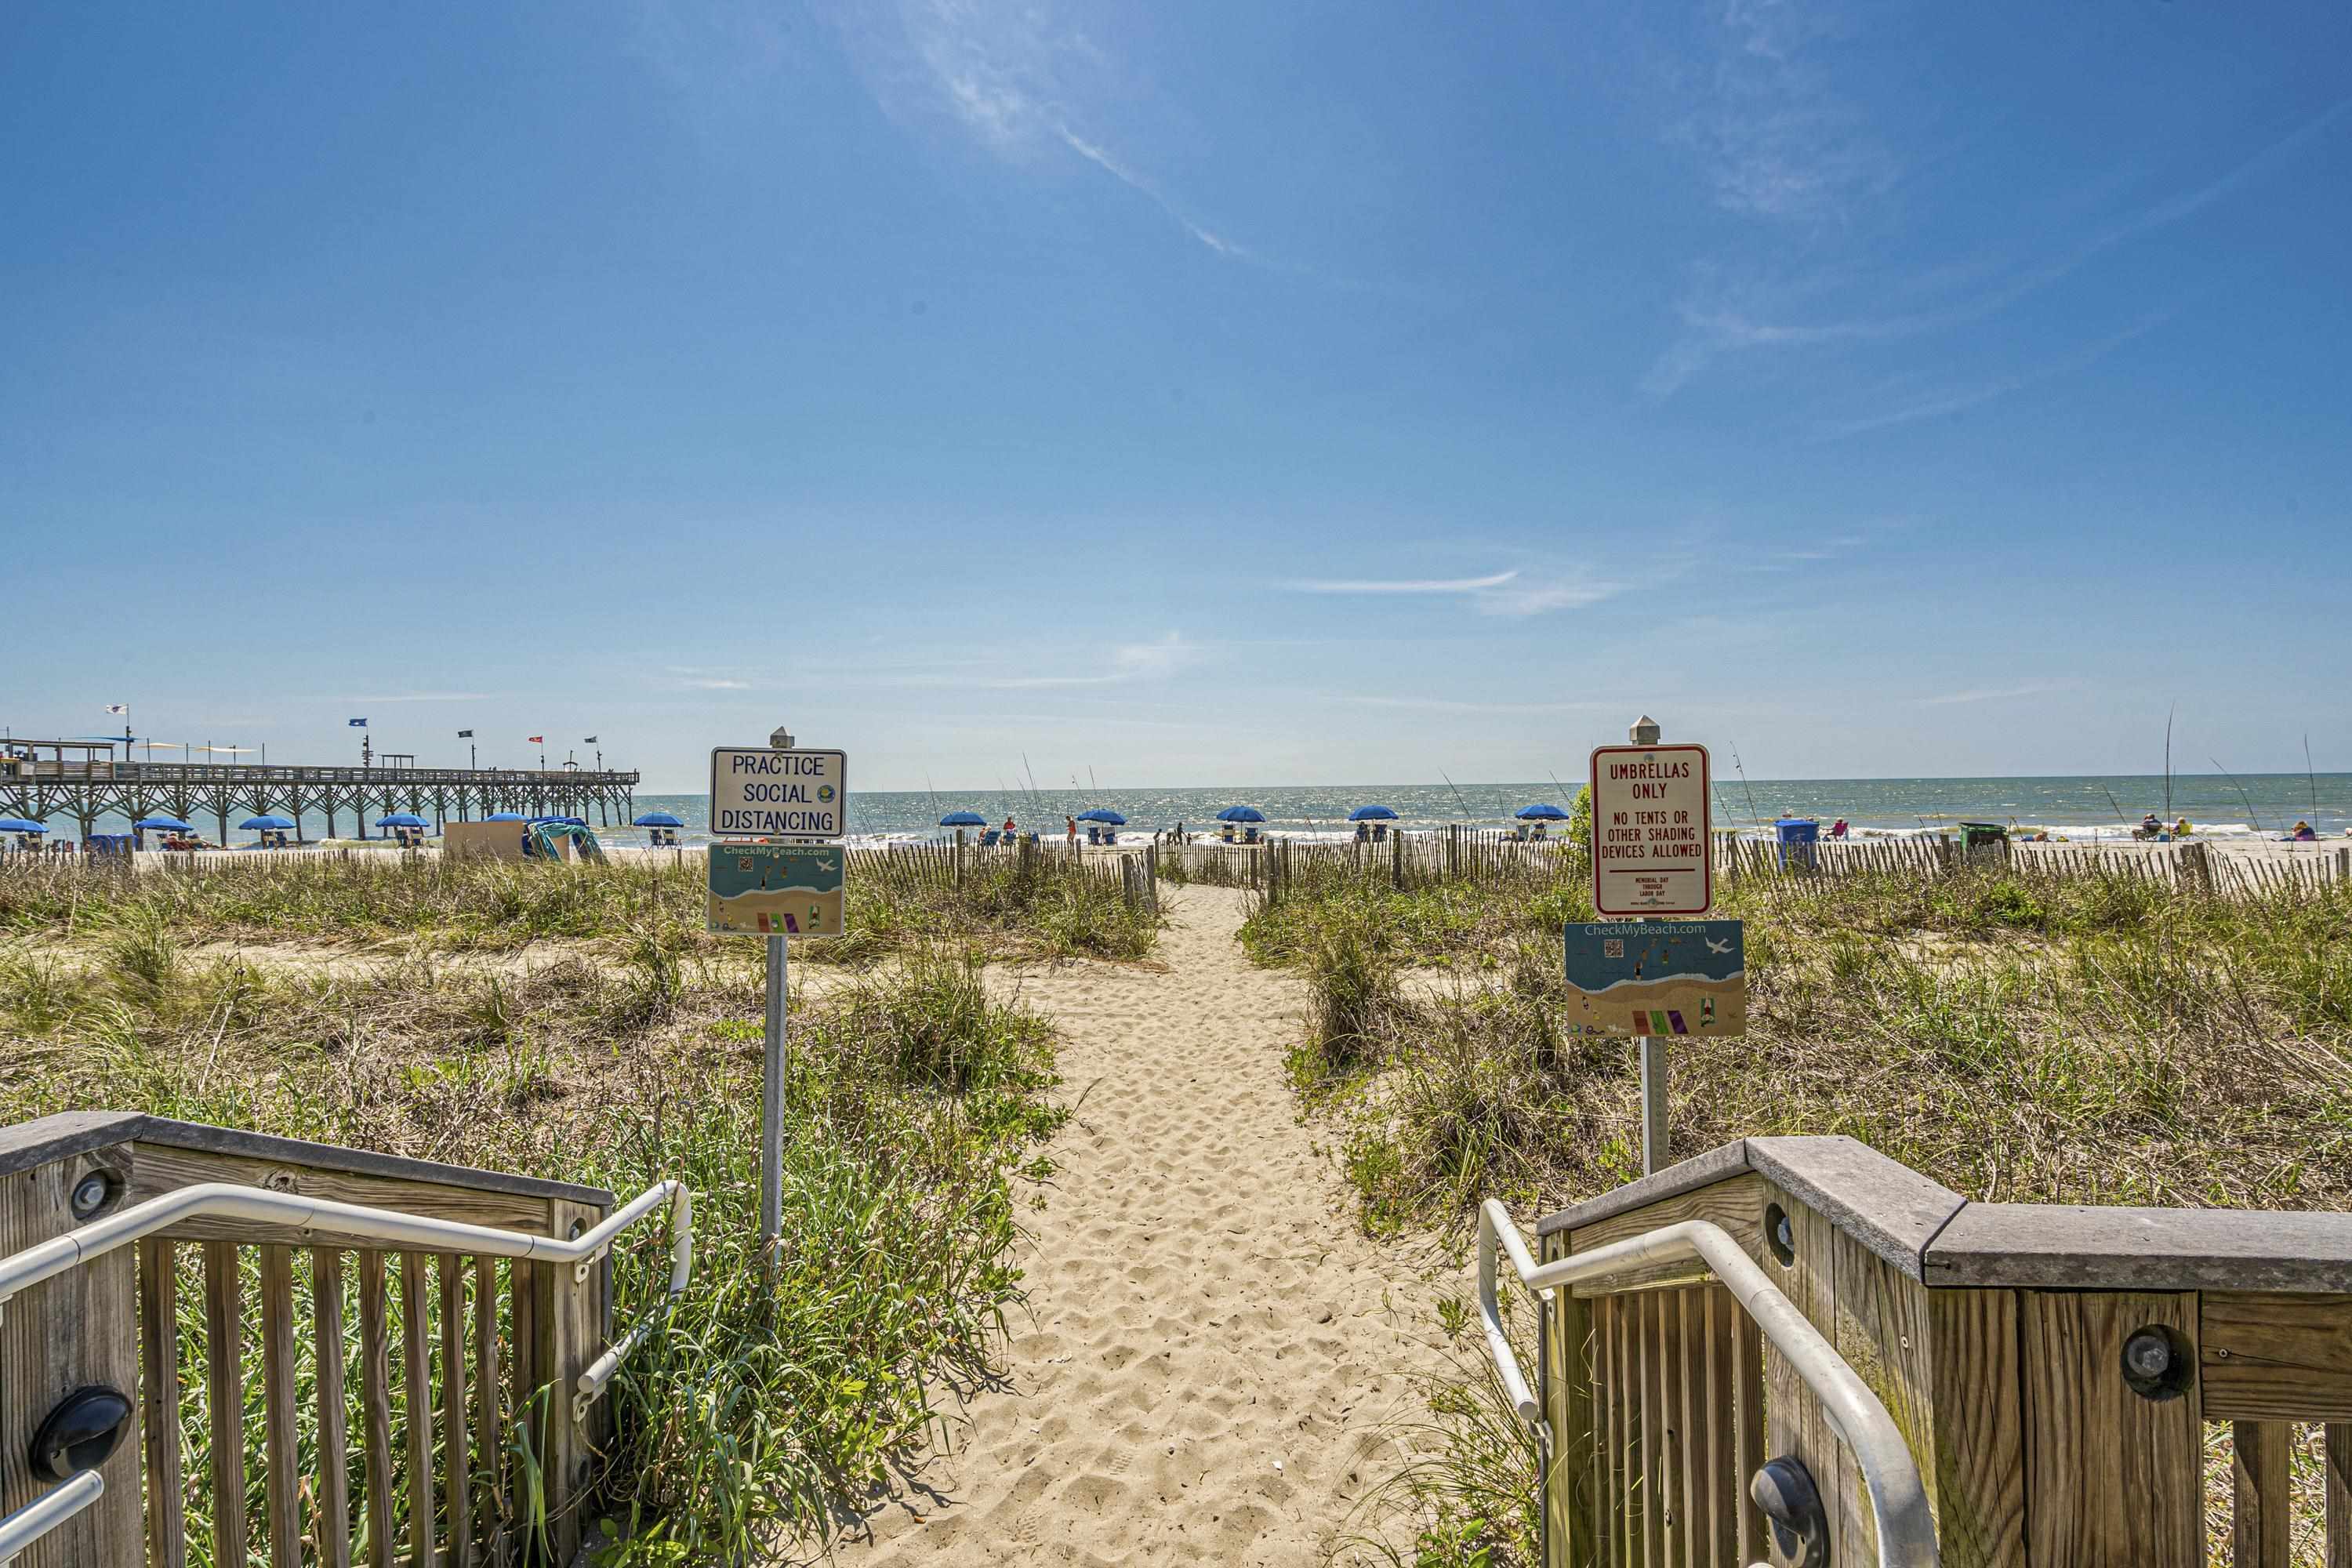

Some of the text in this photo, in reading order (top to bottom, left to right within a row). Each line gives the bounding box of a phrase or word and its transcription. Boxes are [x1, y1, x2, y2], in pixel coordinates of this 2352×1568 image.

[733, 755, 825, 775] PRACTICE
[1610, 762, 1690, 780] UMBRELLAS
[743, 783, 812, 803] SOCIAL
[1632, 782, 1668, 799] ONLY
[721, 810, 833, 830] DISTANCING
[1613, 811, 1688, 825] NO TENTS OR
[1608, 827, 1695, 842] OTHER SHADING
[1602, 844, 1701, 858] DEVICES ALLOWED
[1584, 923, 1706, 938] CheckMyBeach.com
